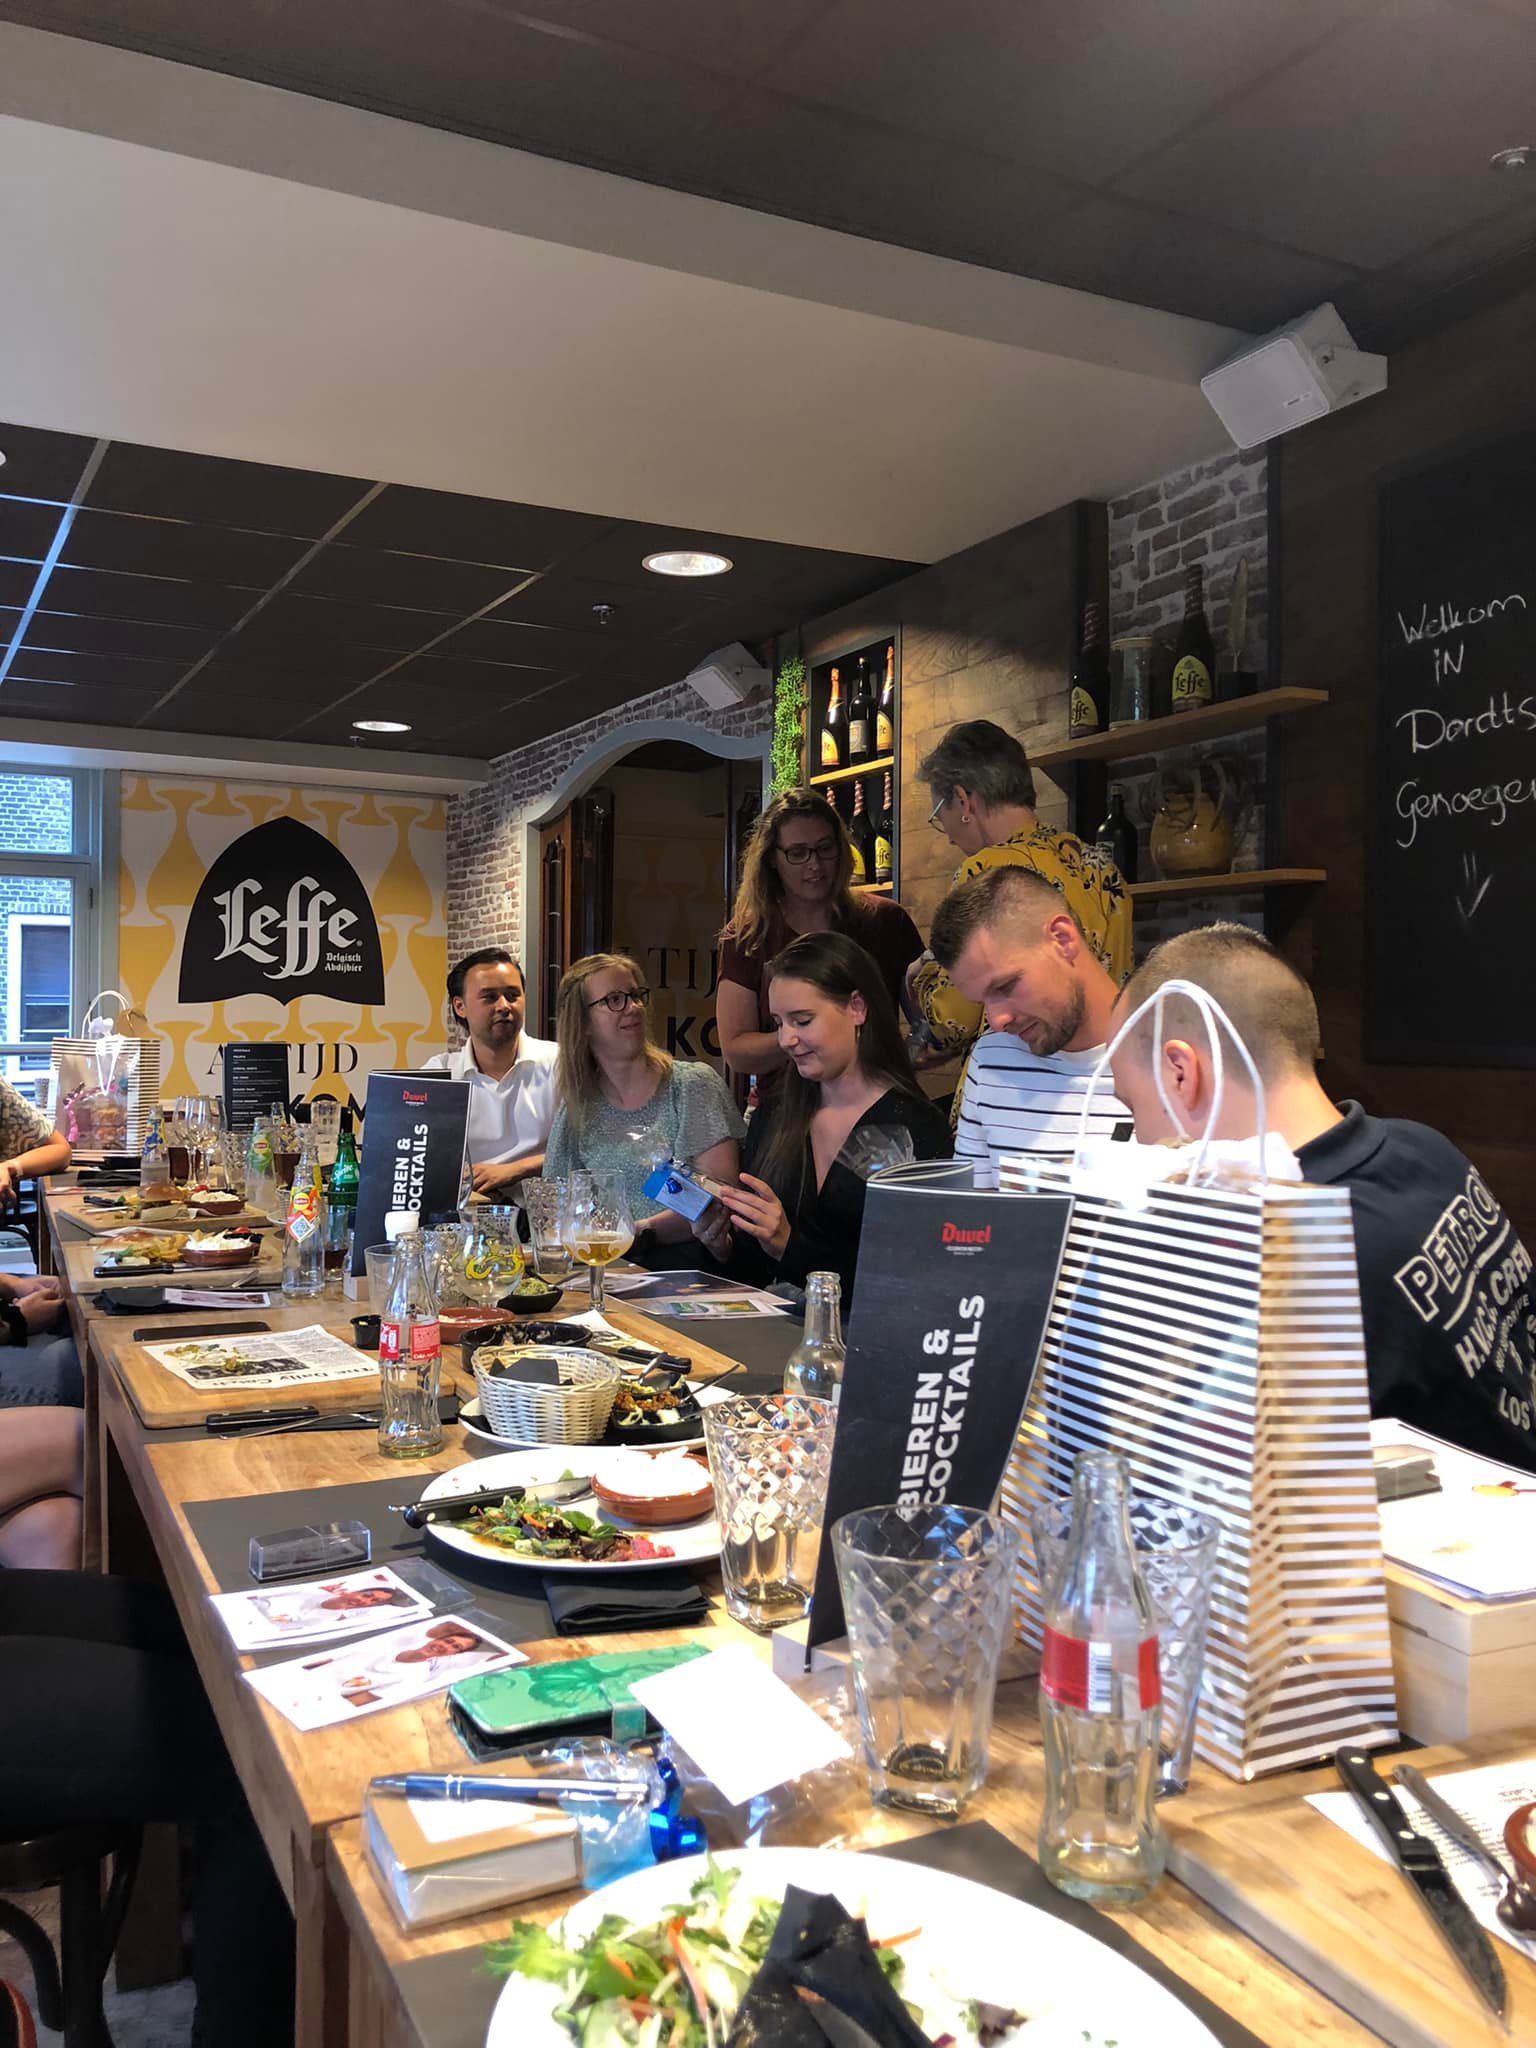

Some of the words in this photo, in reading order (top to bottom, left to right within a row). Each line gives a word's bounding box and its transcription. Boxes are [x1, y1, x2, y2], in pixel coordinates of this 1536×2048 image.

[1397, 594, 1527, 644] Welkom
[1174, 670, 1206, 696] Leffe
[213, 876, 360, 980] Leffe
[324, 962, 364, 974] Abdijbier
[206, 1042, 359, 1081] AIJD
[396, 1137, 411, 1151] &
[391, 1157, 410, 1210] IEREN
[407, 1123, 429, 1211] OCKTAILS
[941, 1221, 992, 1244] Duvel
[1394, 1164, 1500, 1322] PETRO
[922, 1328, 950, 1355] &
[923, 1294, 986, 1509] COCKTAILS
[1499, 1386, 1531, 1431] LOS
